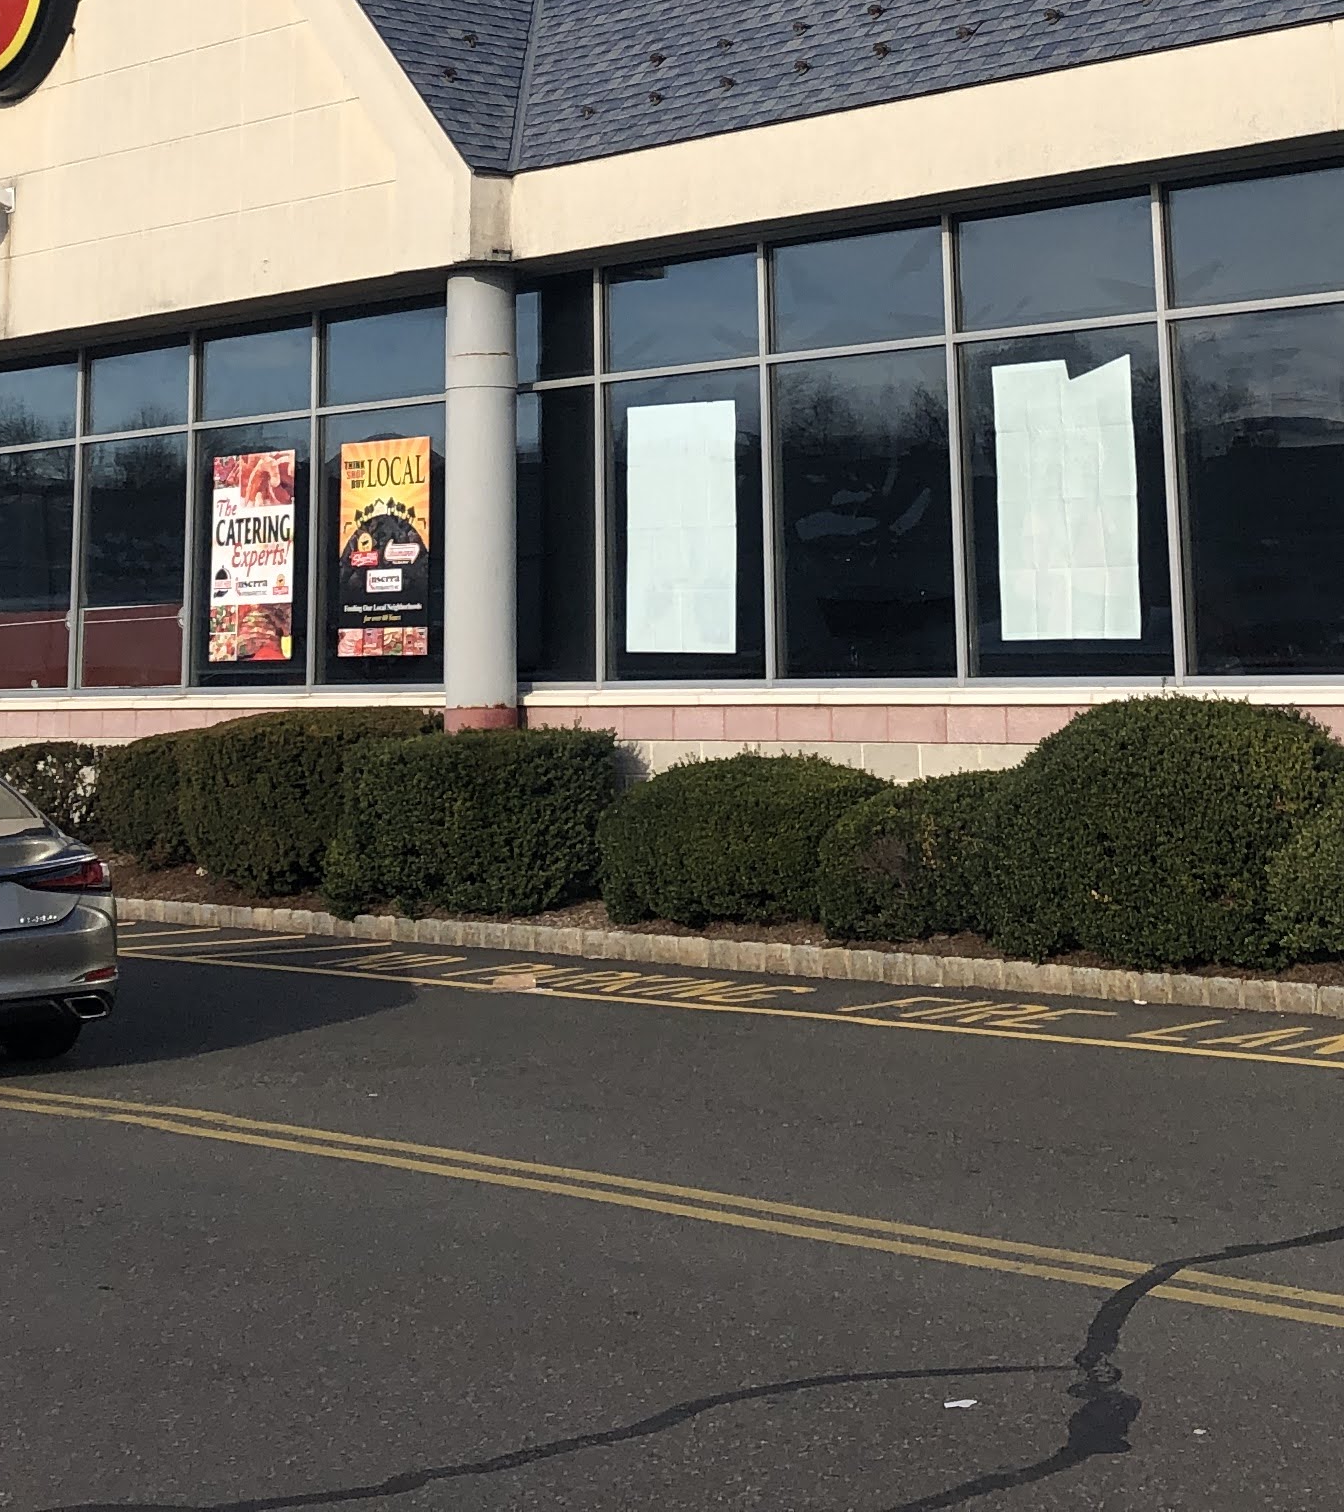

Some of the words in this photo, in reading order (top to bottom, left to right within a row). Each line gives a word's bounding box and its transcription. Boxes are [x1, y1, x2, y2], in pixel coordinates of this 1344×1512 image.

[344, 460, 365, 470] THINK
[347, 470, 365, 479] SHOP
[367, 455, 425, 487] LOCAL
[216, 497, 238, 517] The
[216, 514, 291, 546] CATERING
[231, 539, 292, 577] Experts!
[837, 996, 1118, 1028] FIRE
